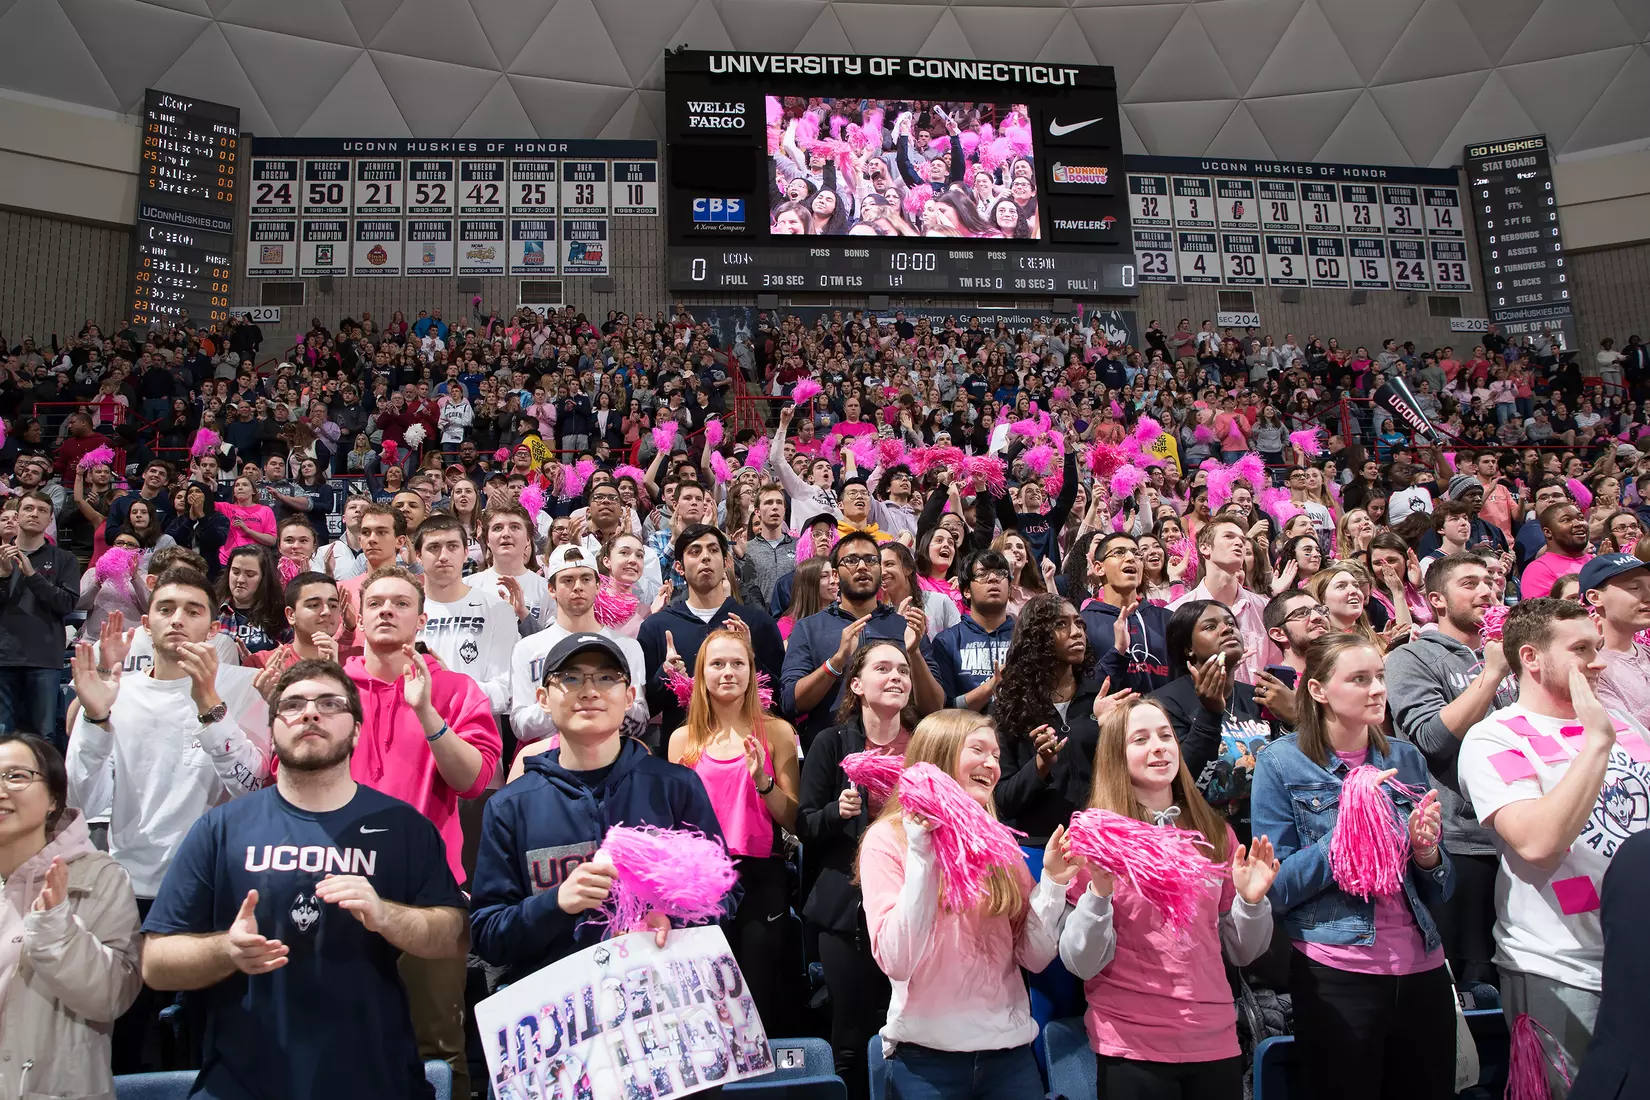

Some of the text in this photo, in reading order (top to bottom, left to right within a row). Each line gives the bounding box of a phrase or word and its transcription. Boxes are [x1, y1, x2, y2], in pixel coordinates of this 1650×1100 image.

[709, 56, 1078, 85] UNIVERSITY OF CONNECTICUT
[687, 102, 745, 113] WELLS
[689, 117, 745, 128] FARGO
[149, 124, 158, 133] 13
[145, 137, 158, 146] 20
[408, 143, 477, 151] HUSKIES
[1471, 139, 1543, 157] GO HUSKIES
[144, 151, 157, 160] 25
[519, 163, 548, 171] SVETLANA
[1482, 157, 1536, 172] STAT BOARD
[1069, 167, 1108, 175] DUNKIN'
[1202, 162, 1387, 178] UCONN HUSKIES OF HONOR
[364, 172, 395, 180] RIZZOTTI
[417, 172, 446, 180] WOLTERS
[473, 172, 492, 180] SALES
[628, 173, 642, 181] BIRD
[1067, 175, 1107, 184] DONUTS
[257, 184, 291, 204] 24
[309, 184, 343, 204] 50
[365, 184, 393, 204] 21
[415, 184, 446, 204] 52
[466, 184, 499, 204] 42
[522, 184, 545, 204] 25
[576, 184, 594, 205] 33
[627, 185, 643, 205] 10
[1505, 187, 1521, 195] FG%
[693, 198, 739, 212] CBS
[1142, 197, 1158, 216] 32
[1190, 199, 1198, 218] 3
[1272, 202, 1288, 221] 20
[1314, 204, 1329, 223] 31
[1354, 205, 1371, 225] 23
[1394, 207, 1411, 226] 31
[1434, 209, 1452, 227] 14
[1522, 216, 1531, 224] FG
[259, 223, 287, 231] NATIONAL
[521, 222, 546, 230] NATIONAL
[572, 222, 598, 230] NATIONAL
[1054, 220, 1106, 229] TRAVELERS
[256, 232, 289, 240] CHAMPION
[309, 232, 342, 240] CHAMPION
[362, 232, 394, 240] CHAMPION
[413, 232, 446, 240] CHAMPION
[465, 231, 498, 239] CHAMPION
[519, 231, 547, 239] CHAMPION
[571, 231, 599, 239] CHAMPION
[1501, 231, 1539, 242] REBOUNDS
[811, 249, 830, 257] POSS
[1508, 247, 1537, 256] ASSISTS
[891, 253, 935, 270] 10:00
[1142, 253, 1168, 273] 23
[1194, 255, 1206, 274] 4
[1231, 255, 1255, 276] 30
[1280, 256, 1293, 276] 3
[1504, 261, 1546, 272] TURNOVERS
[692, 259, 706, 281] 0
[1316, 258, 1339, 278] CD
[1360, 260, 1378, 279] 15
[1396, 261, 1424, 280] 24
[1438, 263, 1464, 282] 33
[136, 272, 149, 281] 20
[726, 275, 748, 285] FULL
[764, 275, 804, 285] 3 30 SEC
[821, 276, 862, 286] 0 TM FLS
[1122, 265, 1134, 287] 0
[959, 278, 1002, 288] TM FLS 0
[1015, 279, 1053, 289] 30 SEC 3
[1068, 280, 1088, 289] FULL
[1513, 278, 1541, 287] BLOCKS
[136, 286, 149, 294] 21
[1517, 294, 1542, 303] STEALS
[135, 300, 148, 310] 23
[134, 315, 147, 323] 24
[254, 309, 279, 319] 201
[997, 315, 1031, 323] Pavilion
[1235, 315, 1258, 324] 204
[1467, 320, 1489, 329] 205
[1505, 320, 1562, 334] TIME OF DAY
[1388, 394, 1429, 434] UCONN
[427, 617, 485, 635] SKIES
[245, 844, 376, 876] UCONN
[787, 1050, 794, 1066] 5
